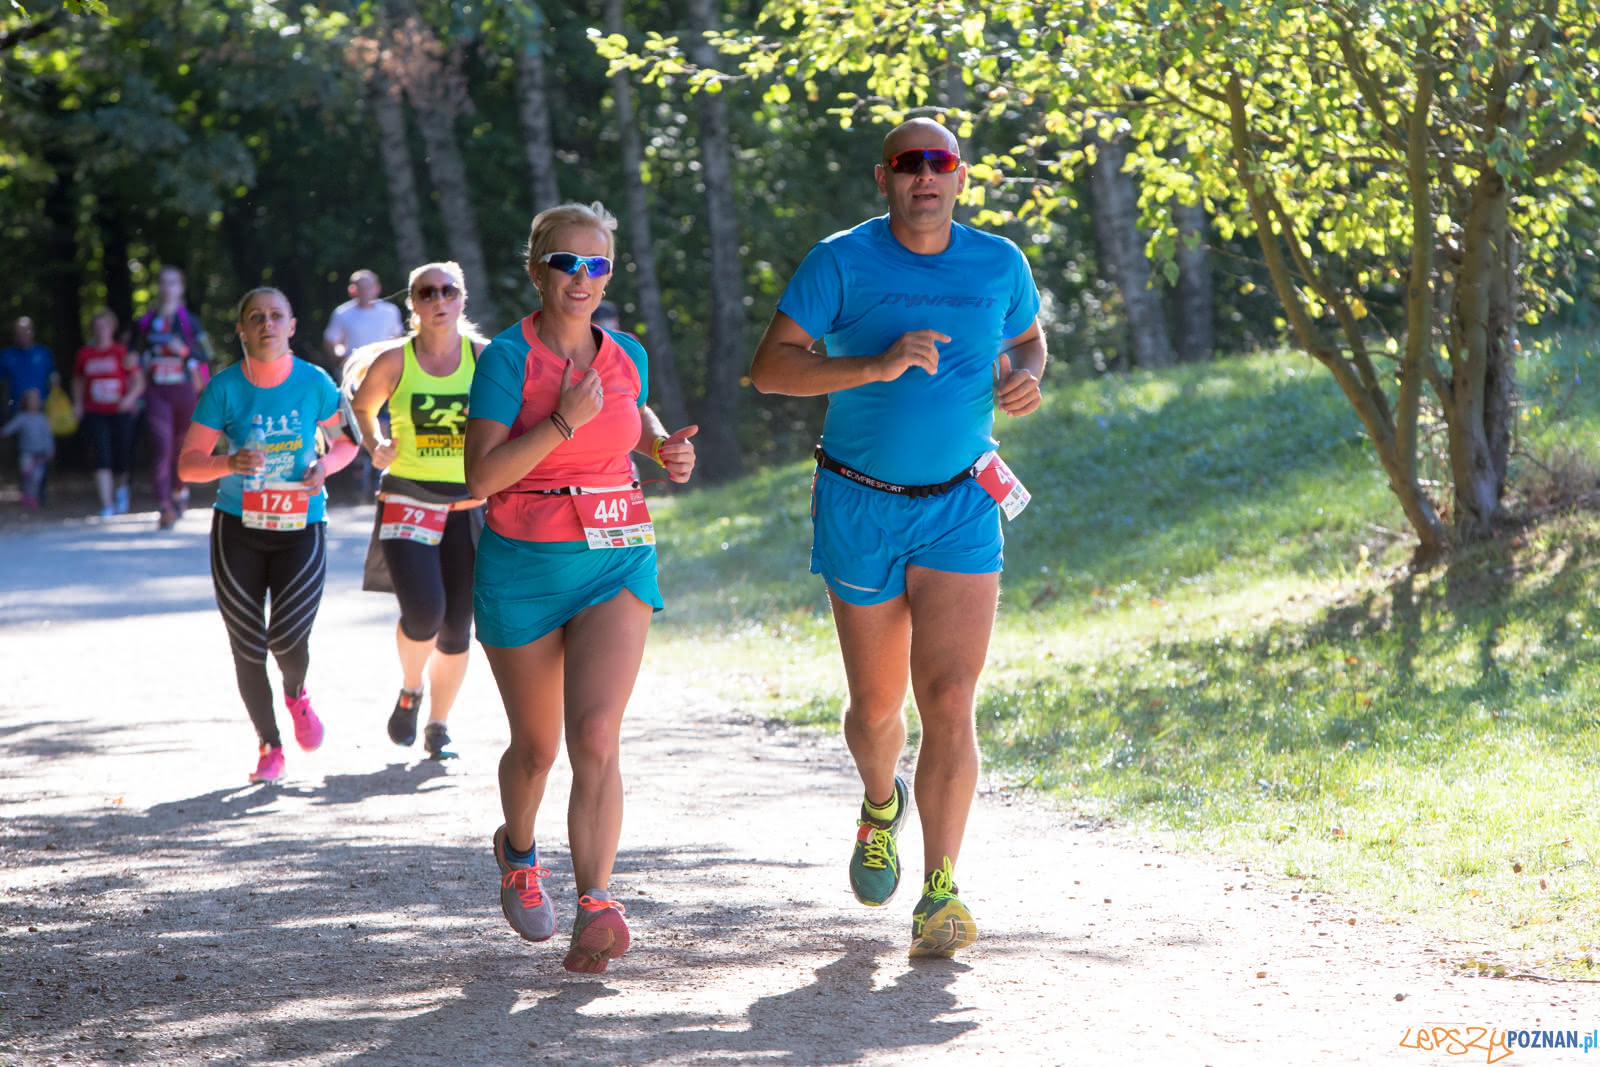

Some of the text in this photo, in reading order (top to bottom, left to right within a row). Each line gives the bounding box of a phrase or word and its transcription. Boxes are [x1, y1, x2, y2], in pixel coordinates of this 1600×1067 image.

[880, 292, 998, 309] DYNAFIT
[260, 493, 293, 512] 176
[594, 497, 628, 523] 449
[402, 507, 426, 524] 79
